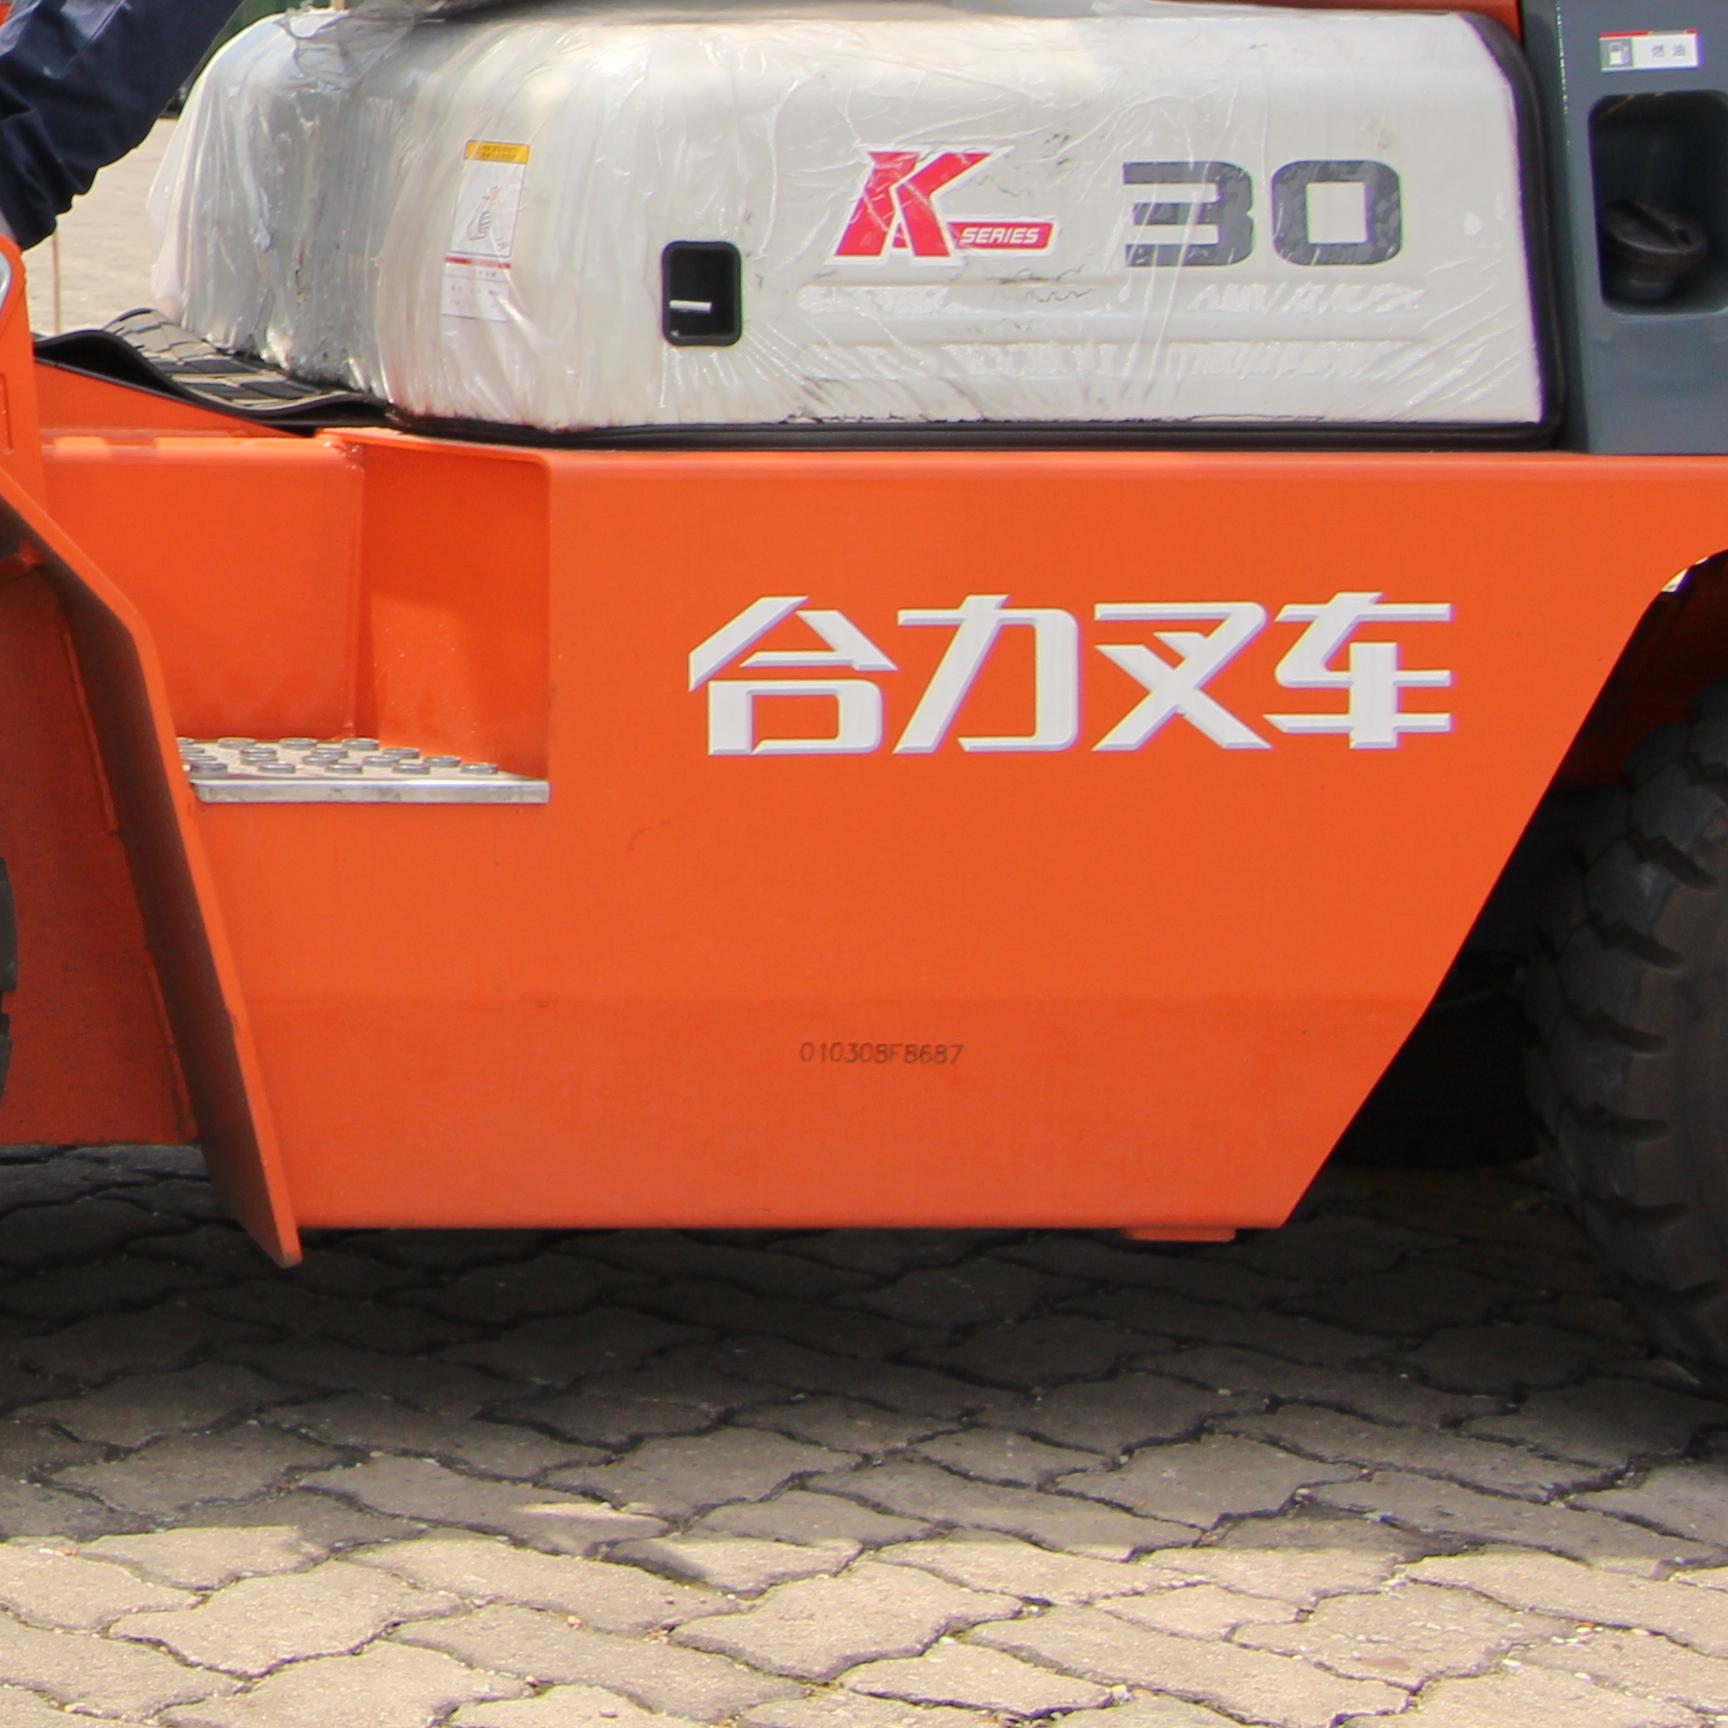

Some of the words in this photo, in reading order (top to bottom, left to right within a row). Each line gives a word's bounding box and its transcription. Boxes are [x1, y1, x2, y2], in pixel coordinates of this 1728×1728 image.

[833, 150, 994, 258] K
[1121, 158, 1403, 268] 30
[957, 225, 1041, 246] SERIES
[688, 591, 1452, 756] 合力叉车
